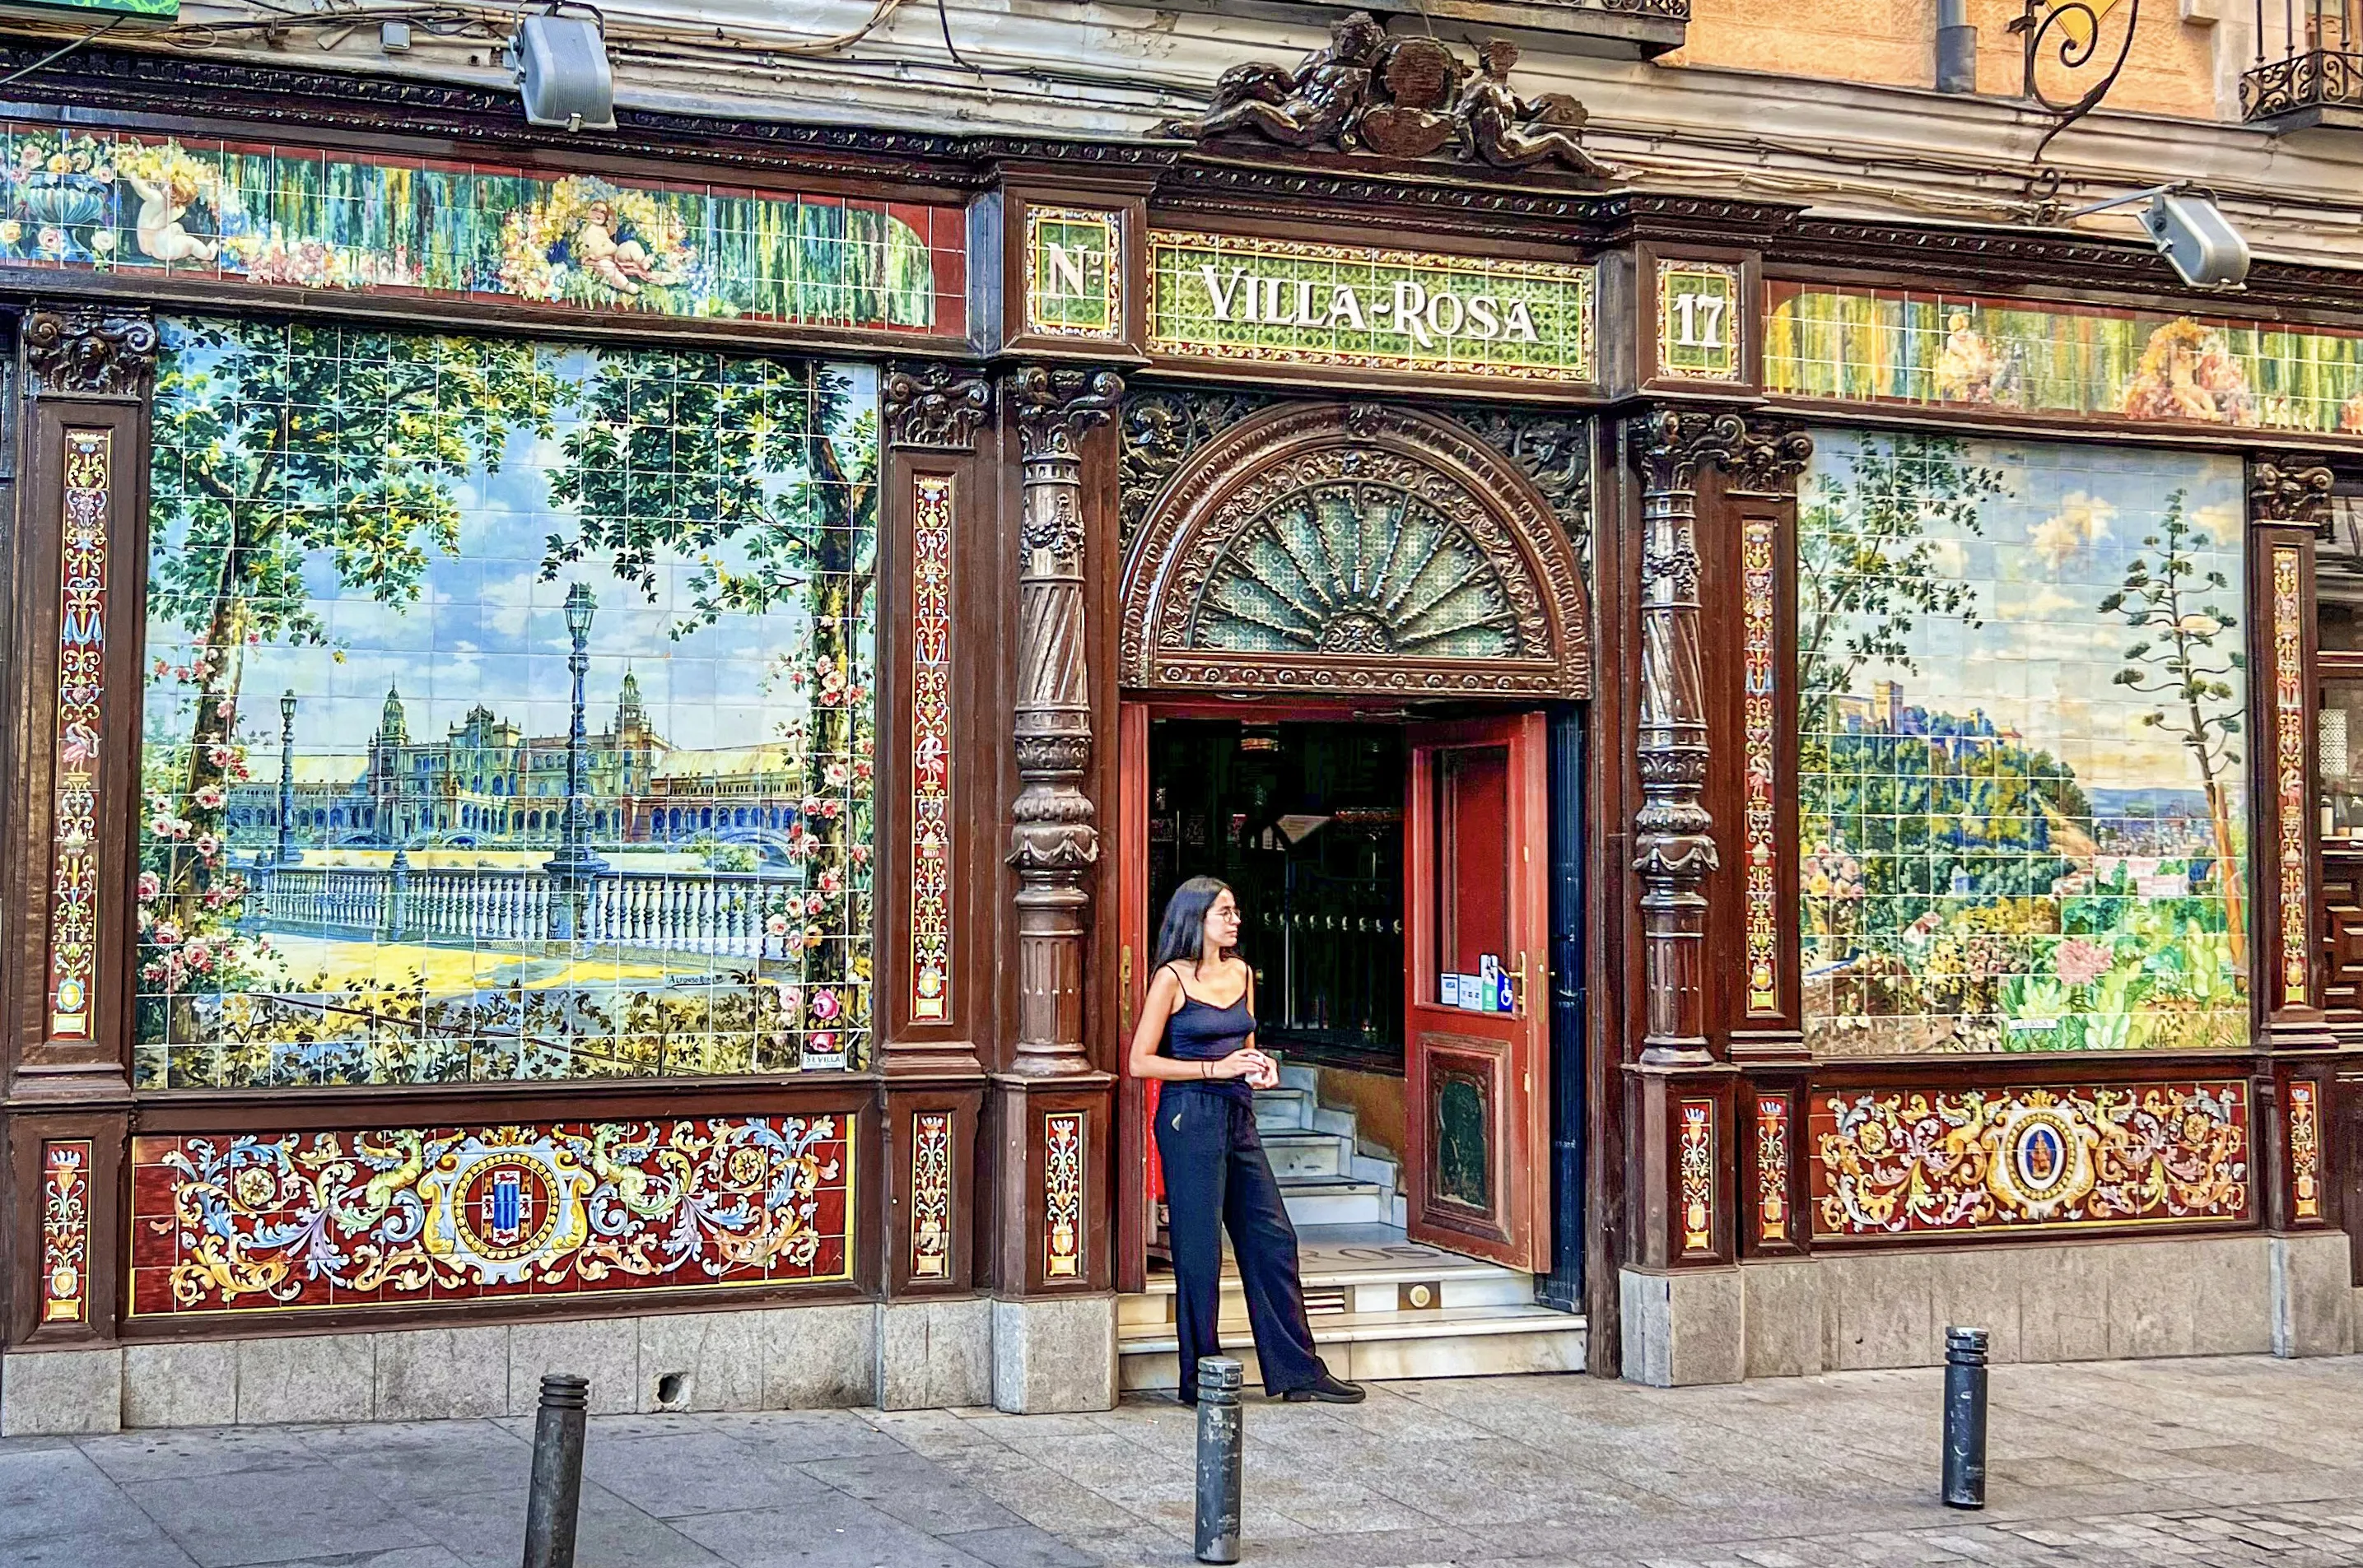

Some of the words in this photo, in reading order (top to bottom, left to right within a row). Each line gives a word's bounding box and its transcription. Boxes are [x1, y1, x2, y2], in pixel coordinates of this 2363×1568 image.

[1199, 263, 1540, 349] VILLA-ROSA
[1672, 293, 1724, 348] 17
[805, 1055, 841, 1063] SEVILLA
